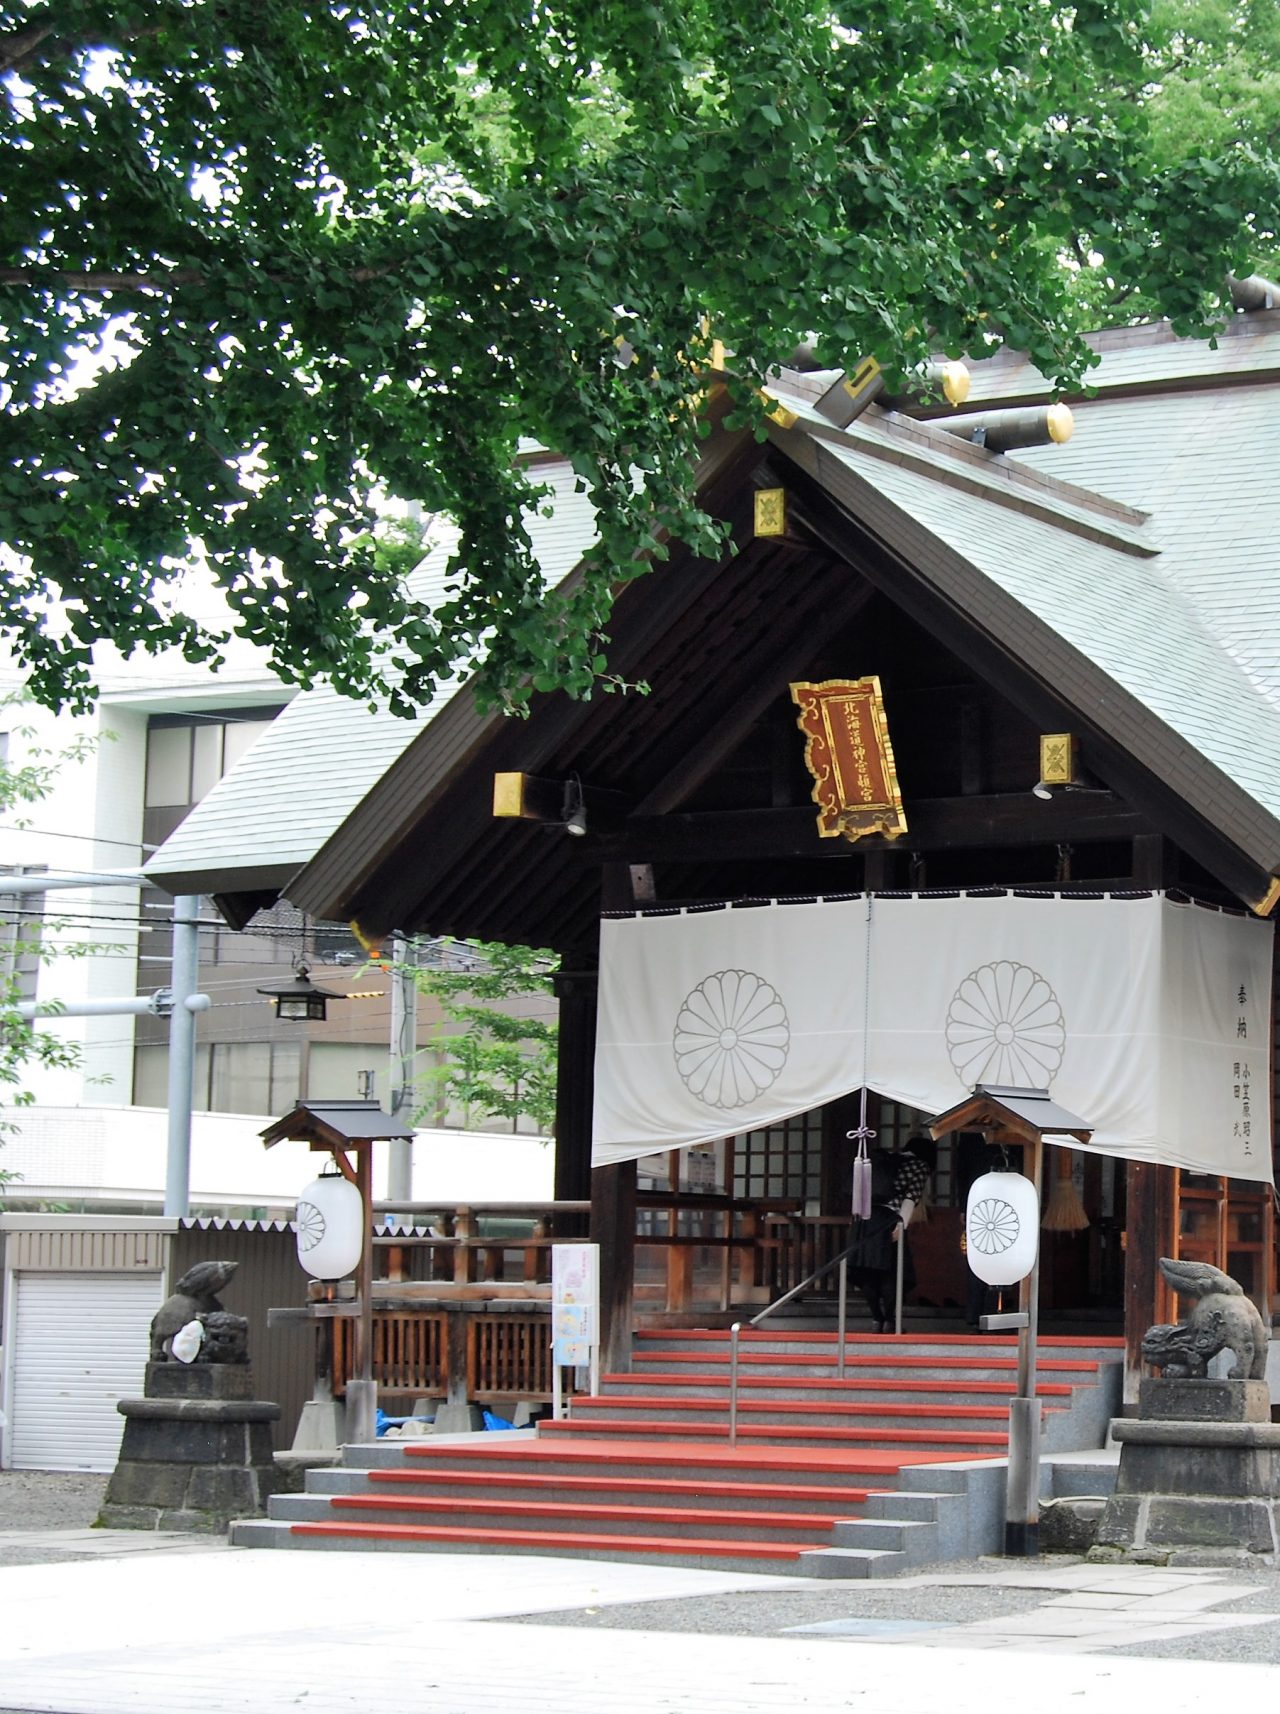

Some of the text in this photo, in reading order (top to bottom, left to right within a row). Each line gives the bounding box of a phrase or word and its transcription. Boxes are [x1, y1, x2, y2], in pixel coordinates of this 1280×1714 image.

[843, 702, 873, 801] 北海道神宮頓宮
